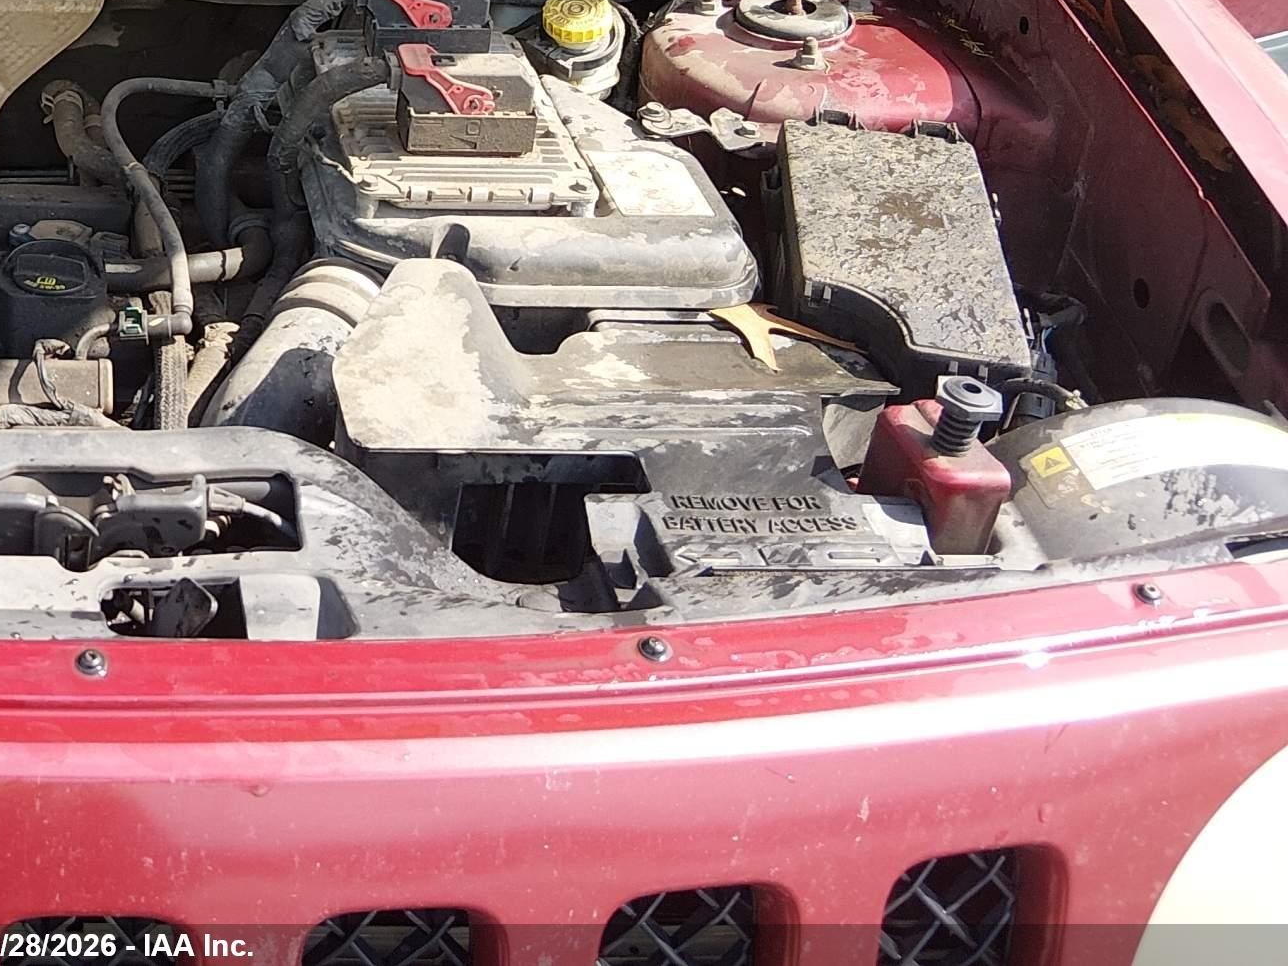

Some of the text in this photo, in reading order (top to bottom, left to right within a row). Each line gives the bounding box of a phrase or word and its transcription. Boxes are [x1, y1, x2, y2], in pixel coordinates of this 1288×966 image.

[670, 494, 822, 511] REMOVE FOR
[662, 515, 858, 534] BATTERY ACCESS
